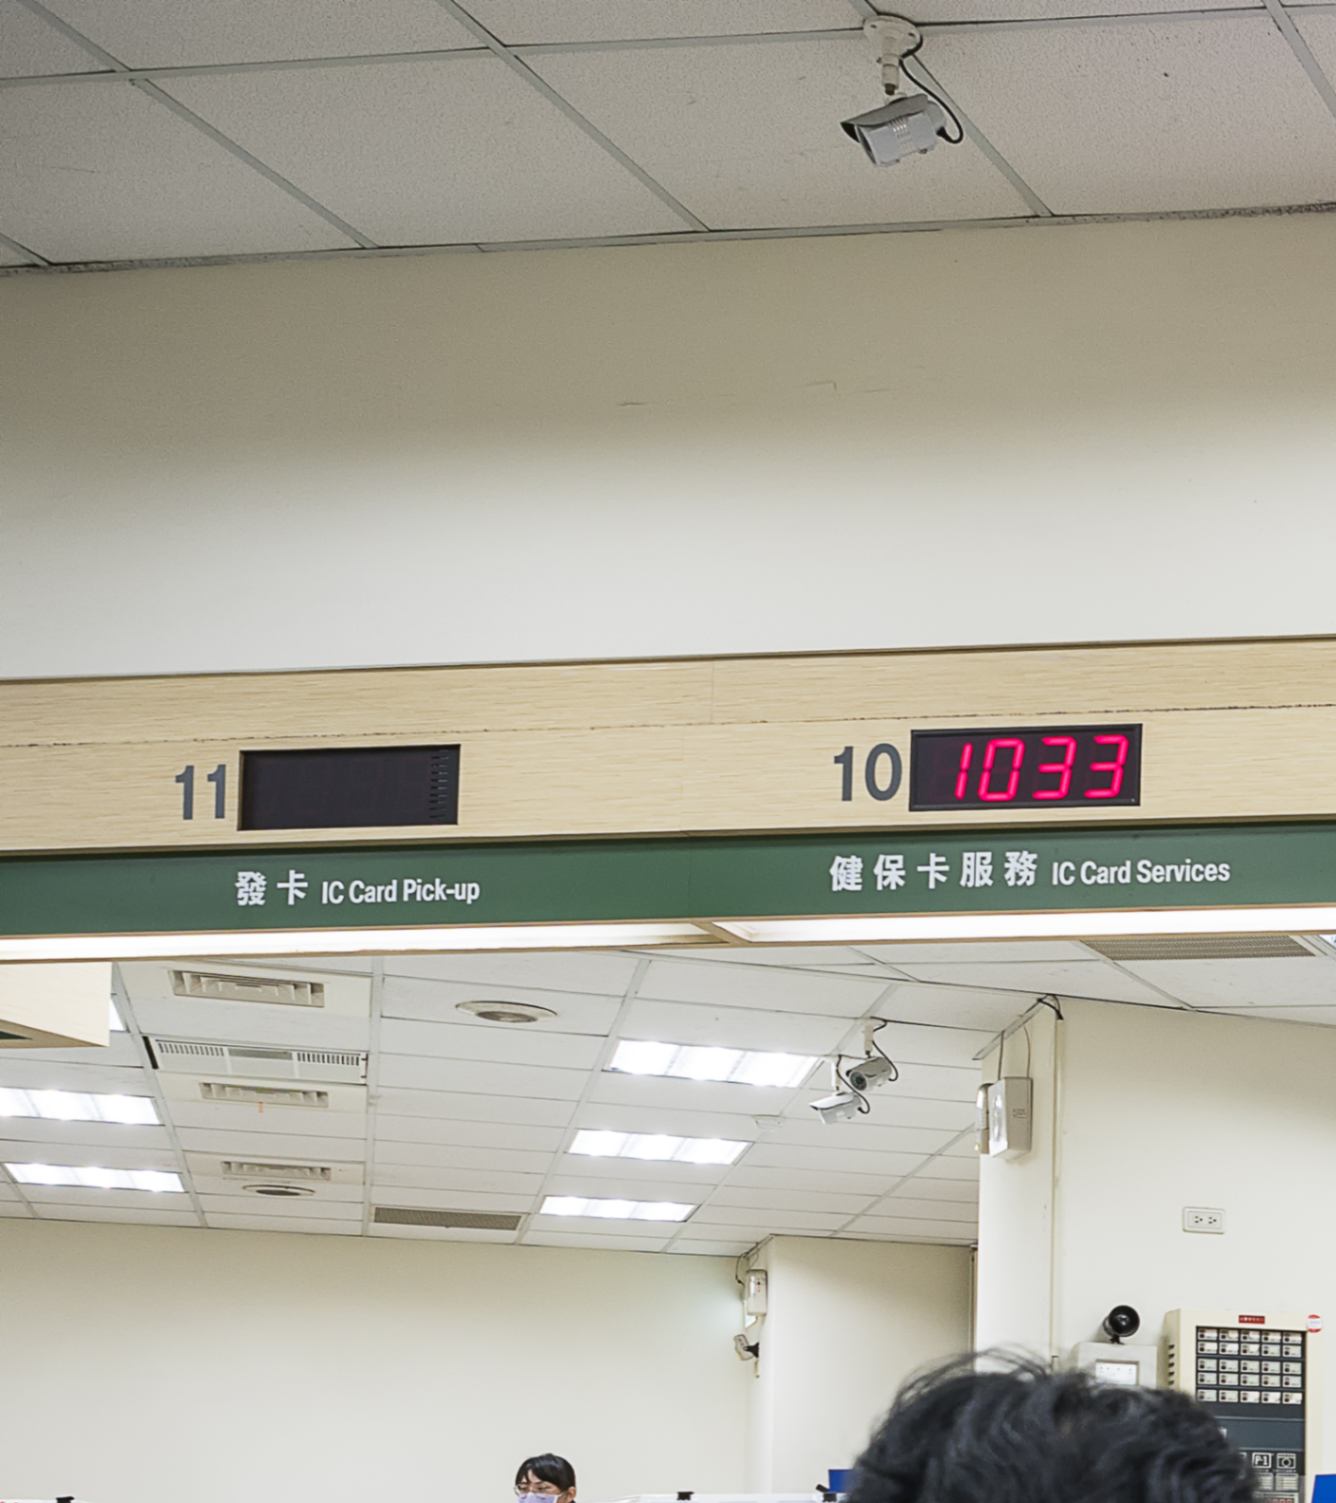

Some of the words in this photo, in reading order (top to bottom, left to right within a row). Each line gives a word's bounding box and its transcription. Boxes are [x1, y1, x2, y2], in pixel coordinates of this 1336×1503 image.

[175, 764, 227, 820] 11
[833, 743, 903, 802] 10
[954, 734, 1130, 802] 1033
[235, 870, 309, 906] 發卡
[321, 880, 345, 905] IC
[348, 879, 397, 904] Card
[403, 876, 480, 904] Pick-up
[830, 851, 1038, 892] 健保卡服務
[1051, 861, 1075, 887] IC
[1079, 860, 1131, 886] Card
[1137, 858, 1231, 885] Services
